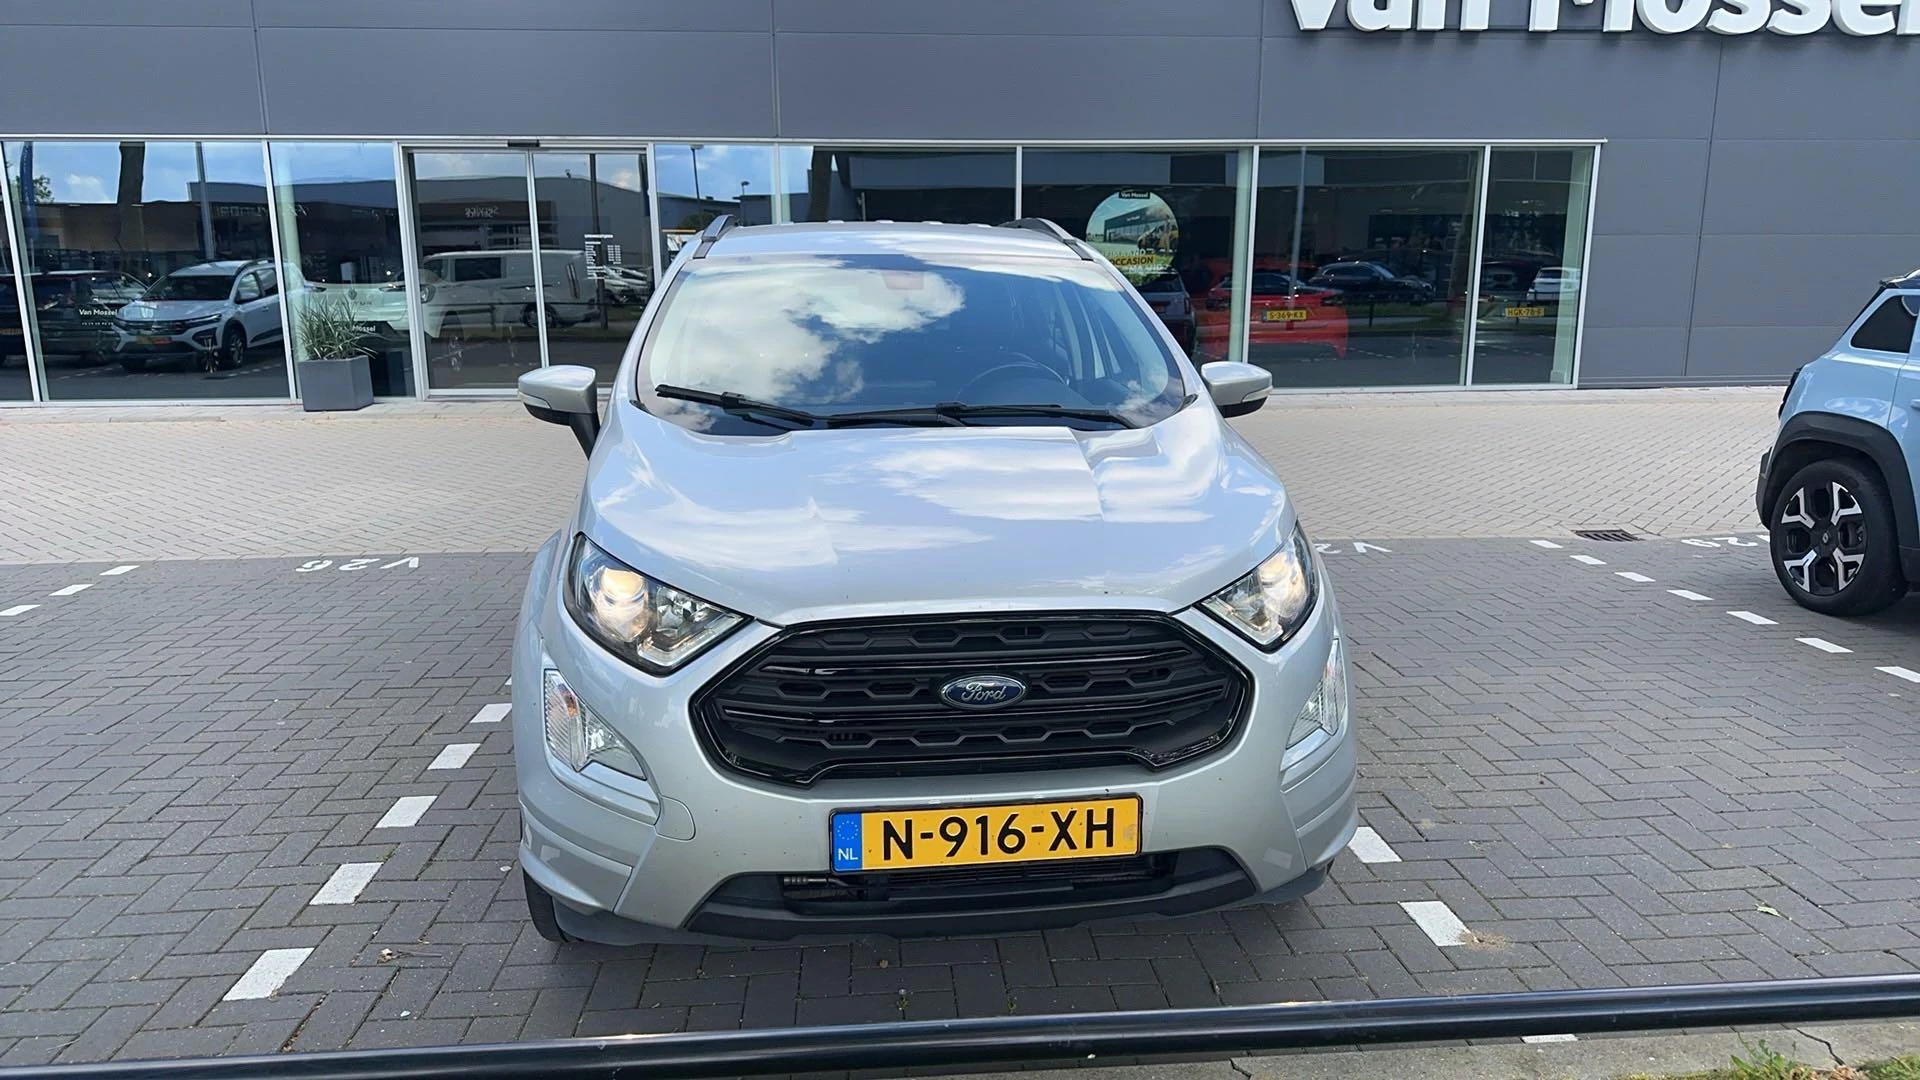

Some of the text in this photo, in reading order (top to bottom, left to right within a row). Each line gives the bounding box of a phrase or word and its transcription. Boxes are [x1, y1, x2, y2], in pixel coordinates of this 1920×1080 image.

[961, 681, 1008, 702] Ford
[883, 807, 1115, 860] N-916-XH
[838, 848, 858, 861] NL
